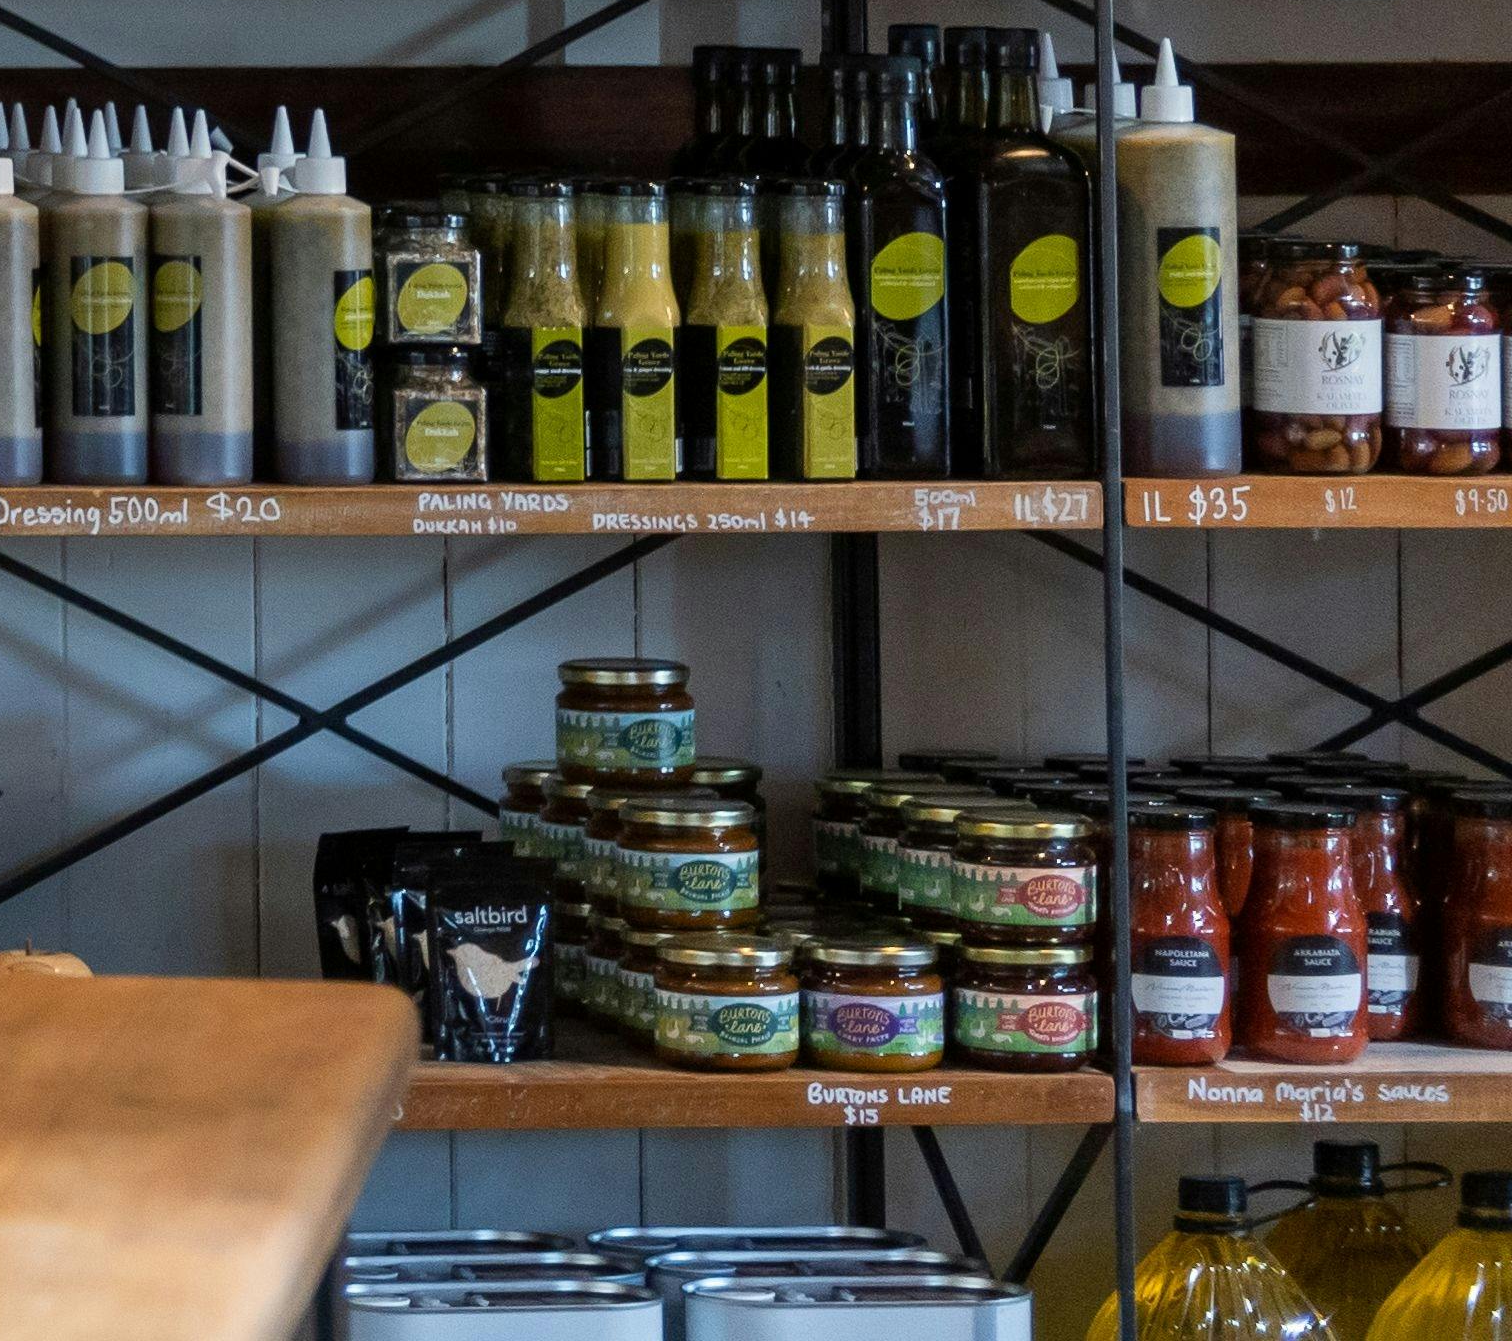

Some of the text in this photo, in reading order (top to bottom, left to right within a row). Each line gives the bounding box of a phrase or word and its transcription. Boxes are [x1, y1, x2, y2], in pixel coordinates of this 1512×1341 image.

[1322, 374, 1365, 385] ROSNAY
[109, 498, 188, 524] 500ml
[206, 493, 281, 522] $20
[418, 493, 568, 513] PALING YARDS
[1188, 486, 1251, 522] $35
[1325, 488, 1357, 512] $12
[414, 518, 482, 534] DUKKAH
[592, 513, 815, 530] DRESSINGS 250ml $14
[455, 905, 527, 925] saltbird
[1155, 950, 1209, 959] NAPOLETANA
[1170, 959, 1198, 967] SAUCE
[1304, 957, 1331, 966] SAUCE
[837, 1008, 889, 1023] BURTONS
[847, 1021, 880, 1032] lane
[808, 1083, 952, 1104] BURTONS LANE
[1188, 1079, 1263, 1103] Nonna
[1300, 1103, 1336, 1122] $12
